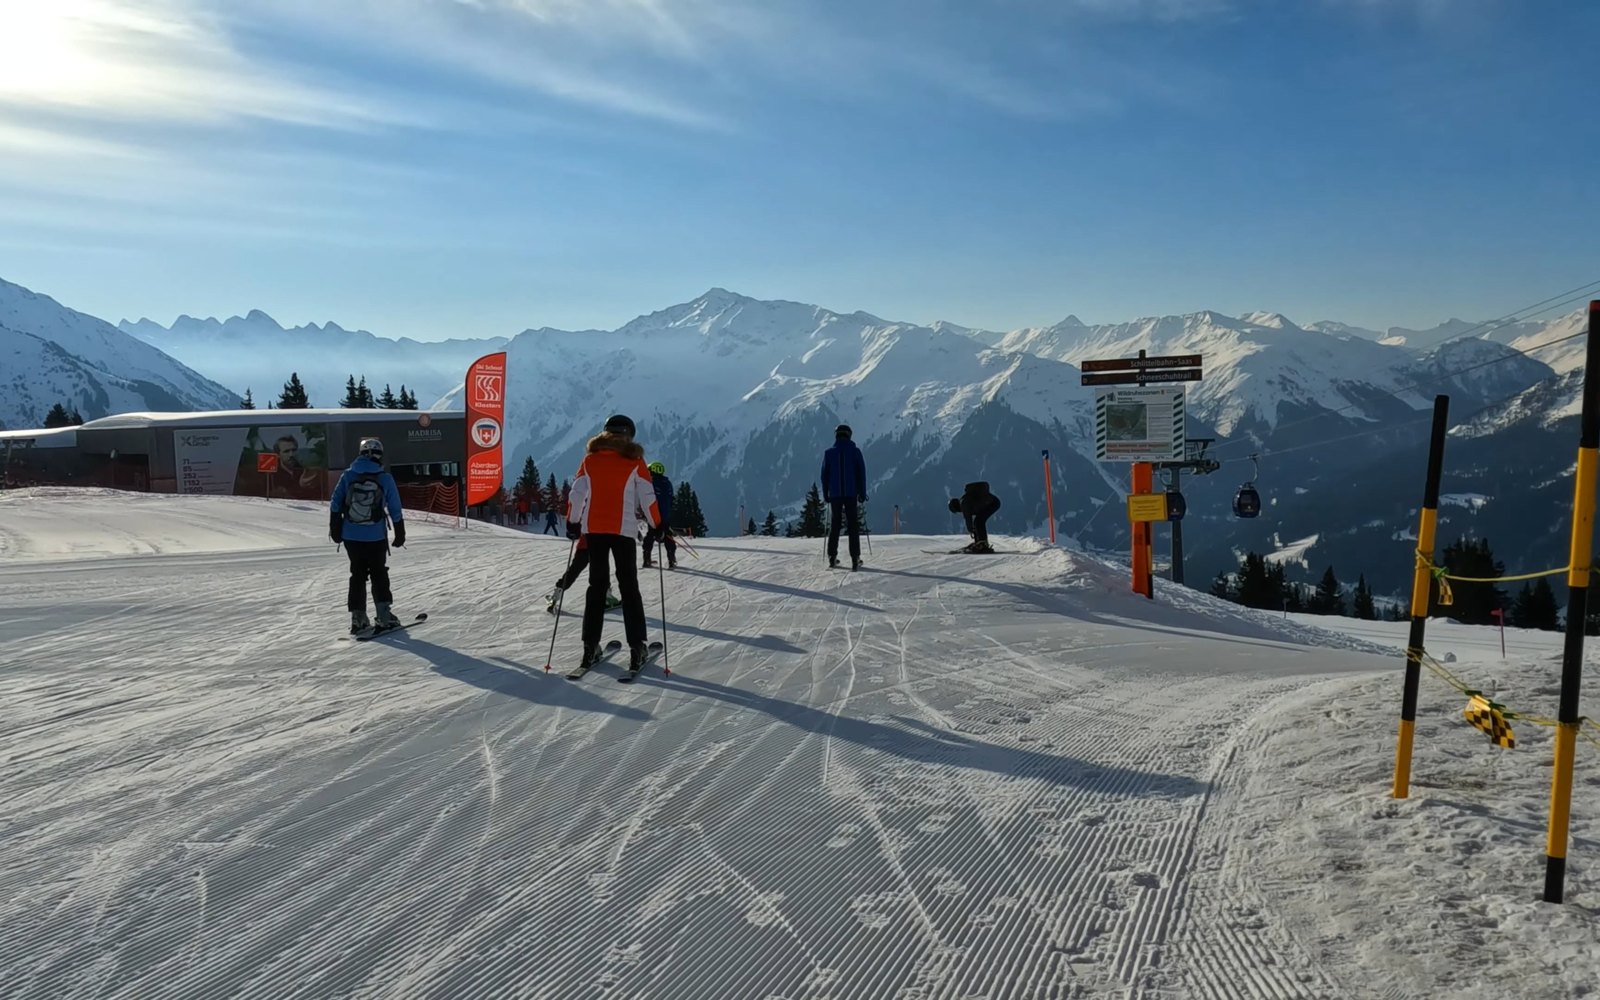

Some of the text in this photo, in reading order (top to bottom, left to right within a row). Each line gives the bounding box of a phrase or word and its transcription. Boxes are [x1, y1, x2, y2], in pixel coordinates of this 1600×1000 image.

[1130, 358, 1193, 368] Schlittelbahn-Saas
[1136, 372, 1192, 382] Schneeschuhtrail
[408, 429, 442, 437] MADRISA
